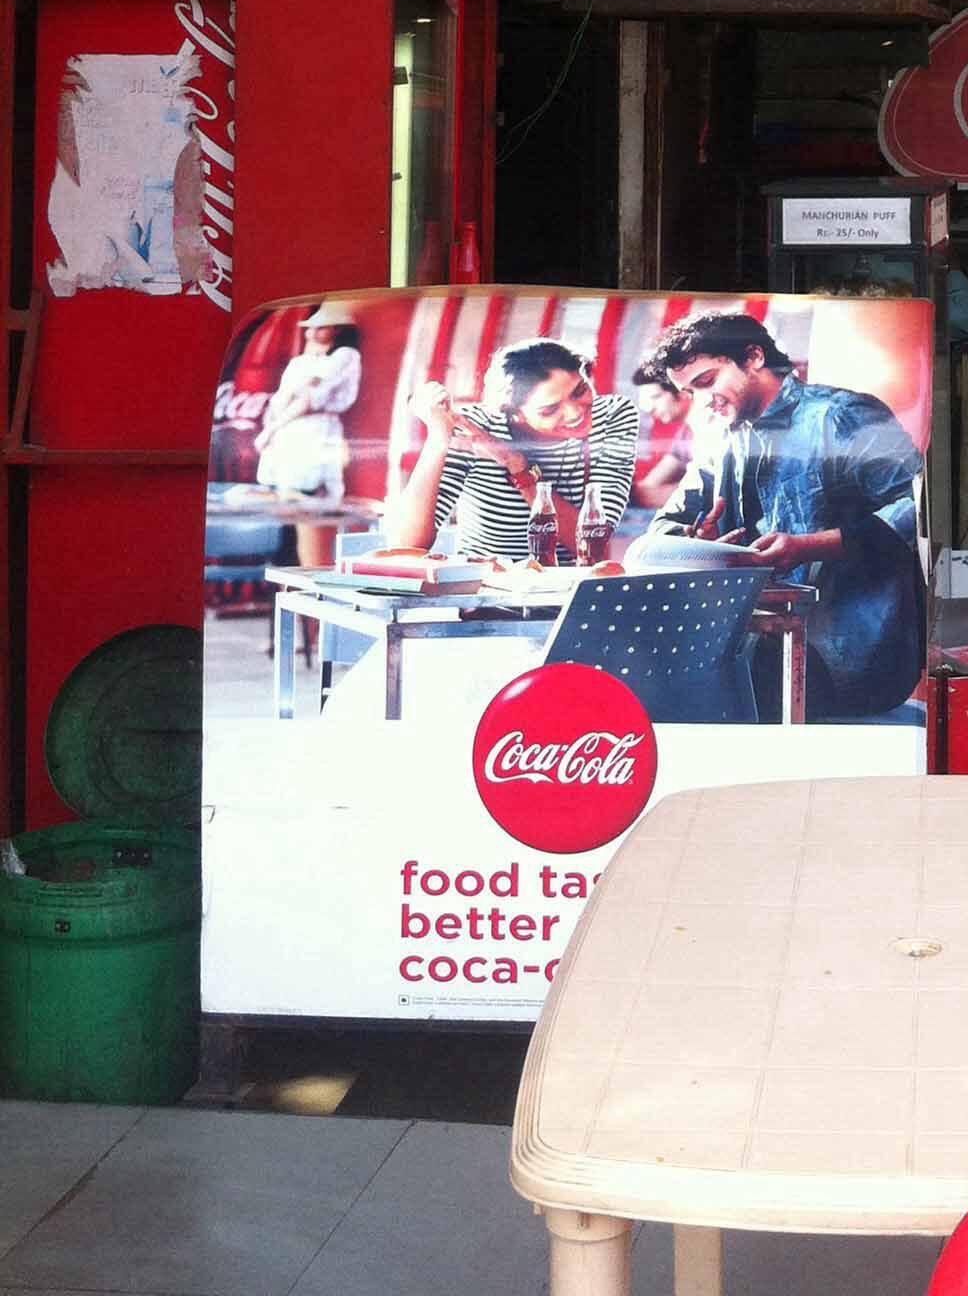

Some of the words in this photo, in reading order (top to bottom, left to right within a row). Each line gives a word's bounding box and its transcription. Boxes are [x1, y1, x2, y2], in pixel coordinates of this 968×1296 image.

[801, 211, 869, 222] MANCHURIAN
[872, 211, 897, 221] PUFF
[857, 228, 880, 239] Only
[484, 730, 646, 785] Coca-Cola
[400, 860, 519, 897] food
[401, 903, 560, 941] better
